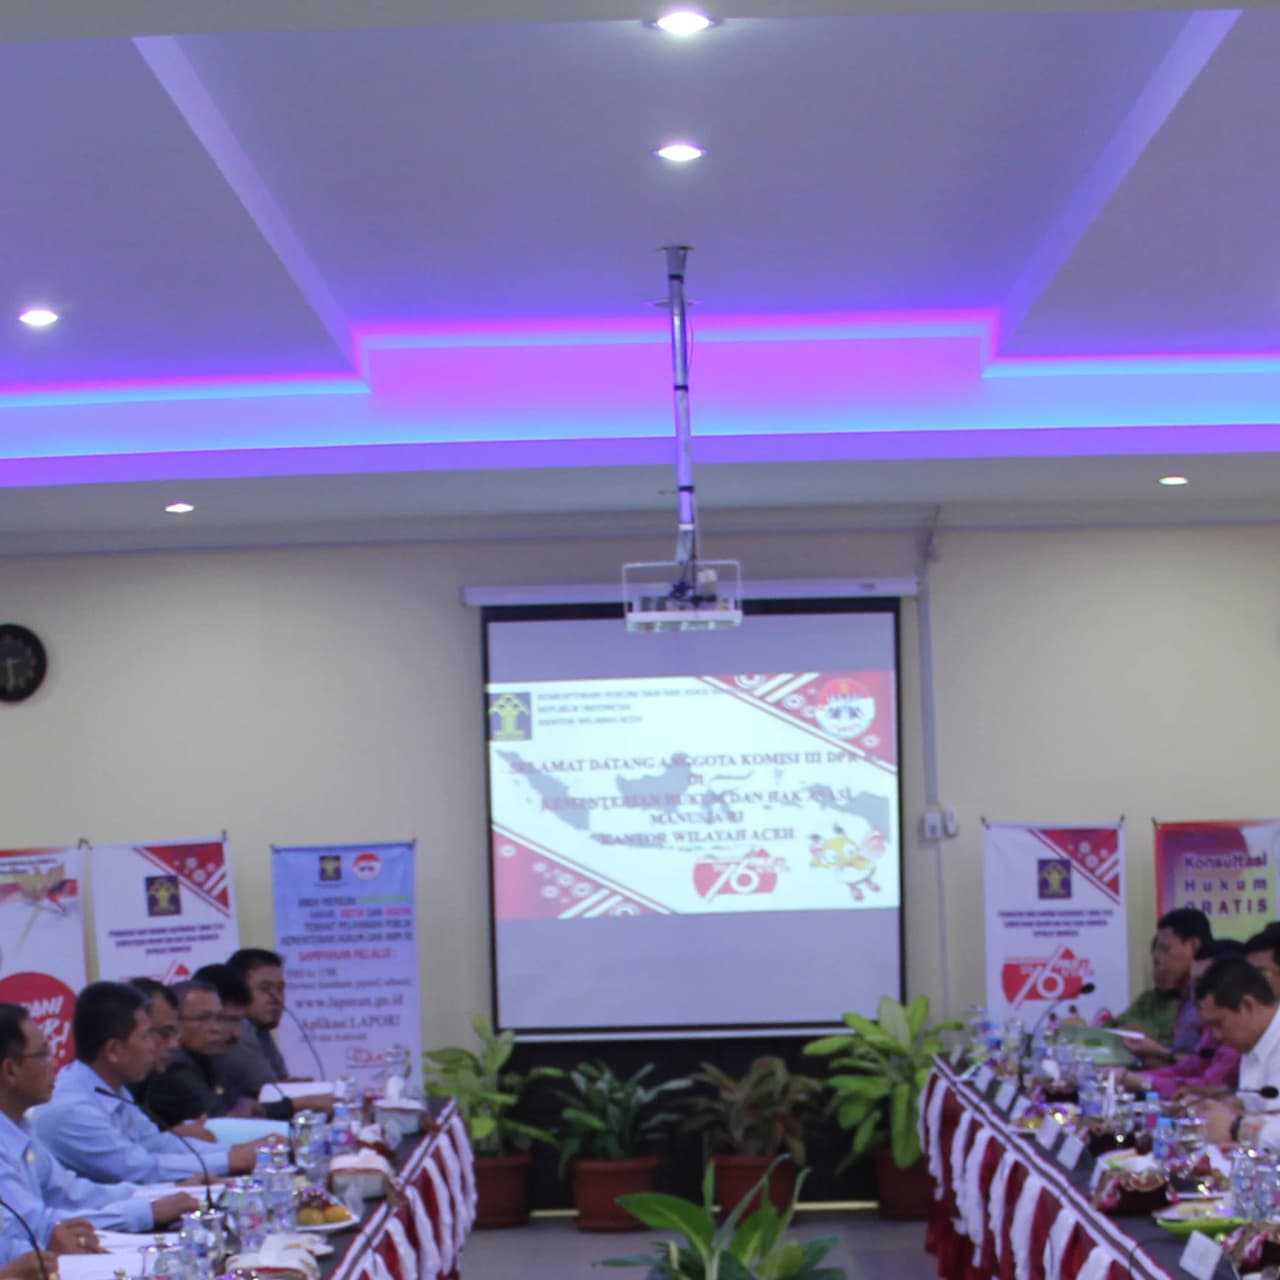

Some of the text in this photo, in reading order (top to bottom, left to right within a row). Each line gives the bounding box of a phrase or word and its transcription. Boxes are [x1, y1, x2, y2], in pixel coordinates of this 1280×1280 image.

[511, 758, 586, 774] LAMAT
[589, 757, 656, 771] DATANG
[741, 752, 800, 767] KOMISI
[804, 751, 823, 765] III
[672, 829, 747, 842] WILAYAH
[751, 827, 795, 840] ACEH
